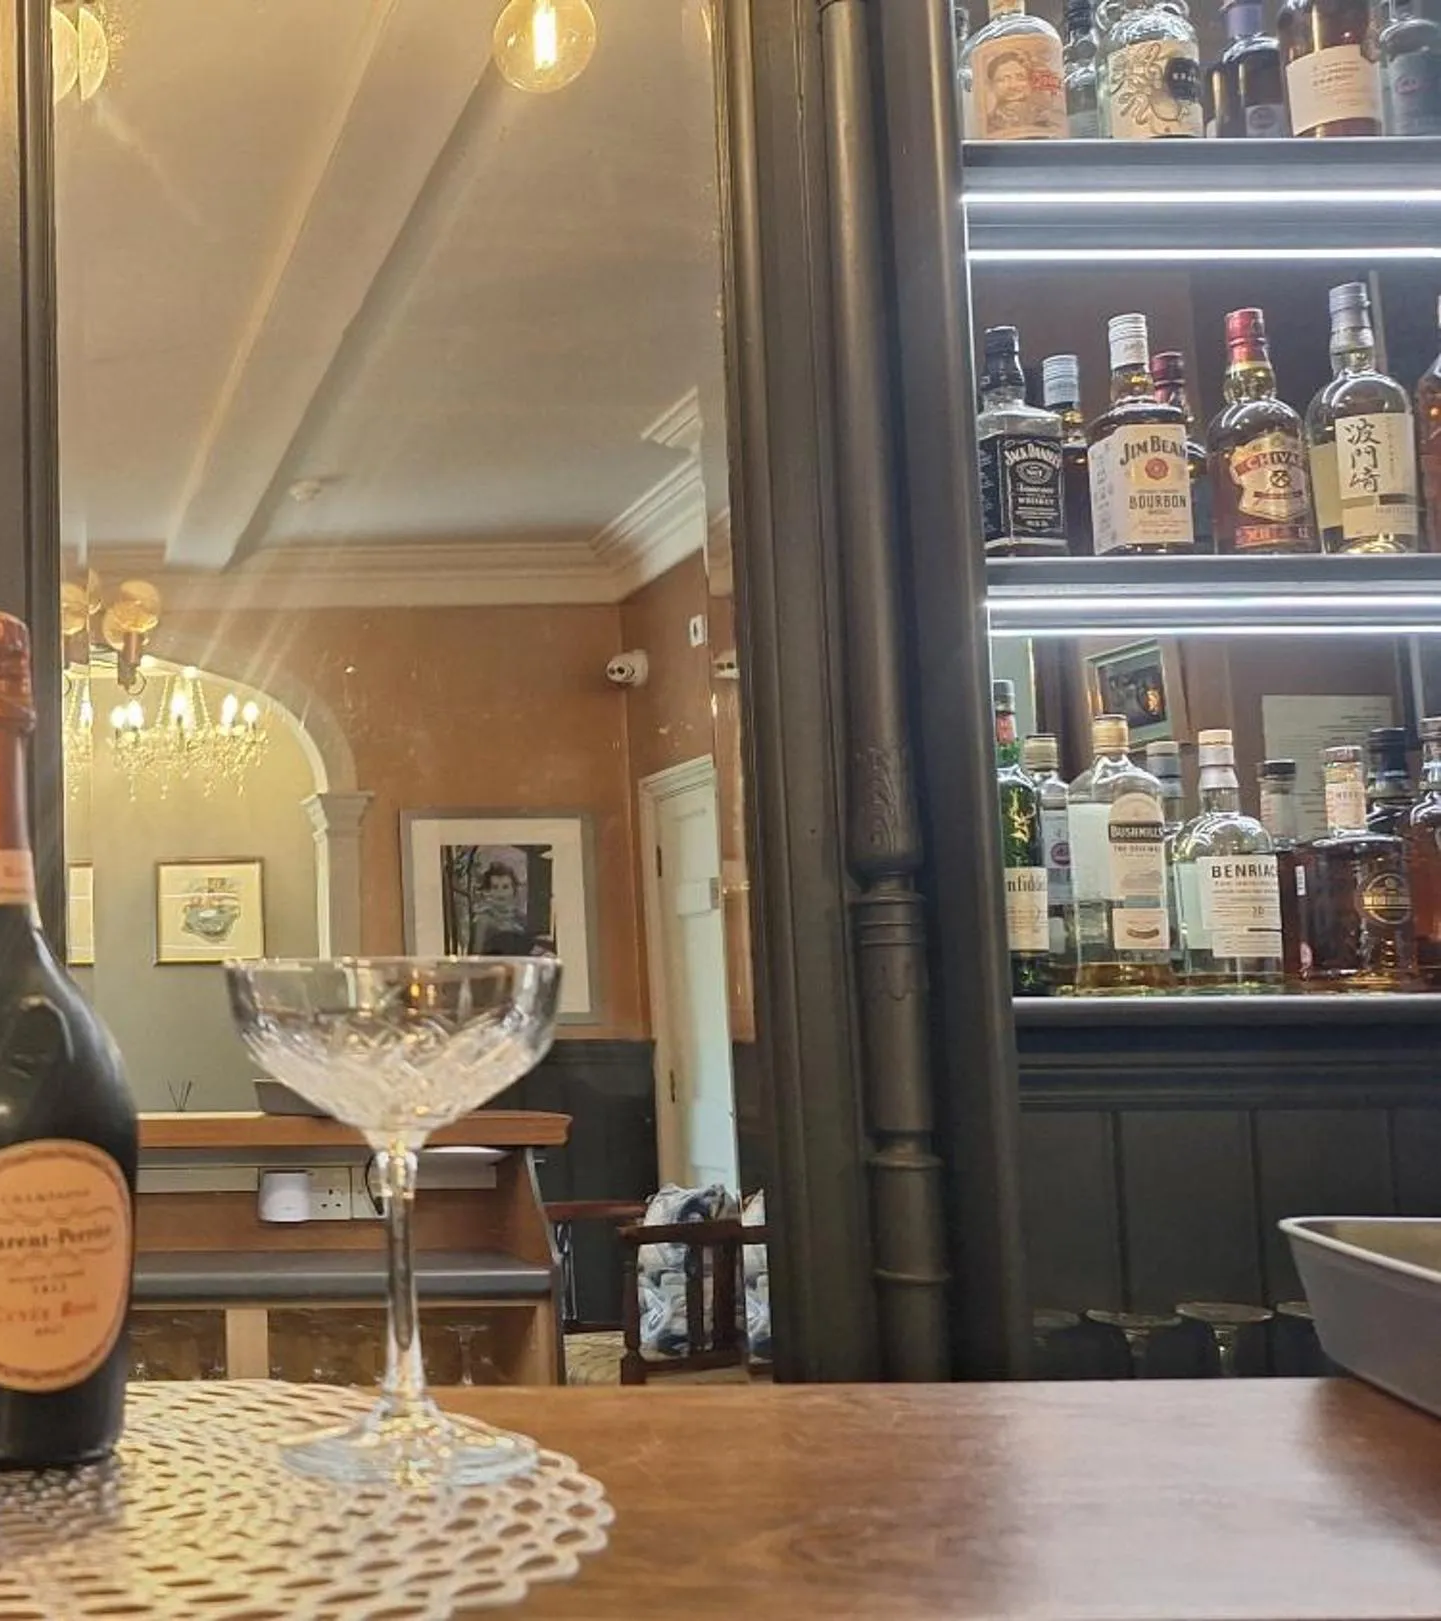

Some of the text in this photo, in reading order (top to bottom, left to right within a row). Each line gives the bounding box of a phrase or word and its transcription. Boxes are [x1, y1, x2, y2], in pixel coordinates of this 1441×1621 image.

[1119, 441, 1148, 465] JIM
[1246, 450, 1301, 469] CHIVA
[1128, 495, 1187, 510] BOURBON
